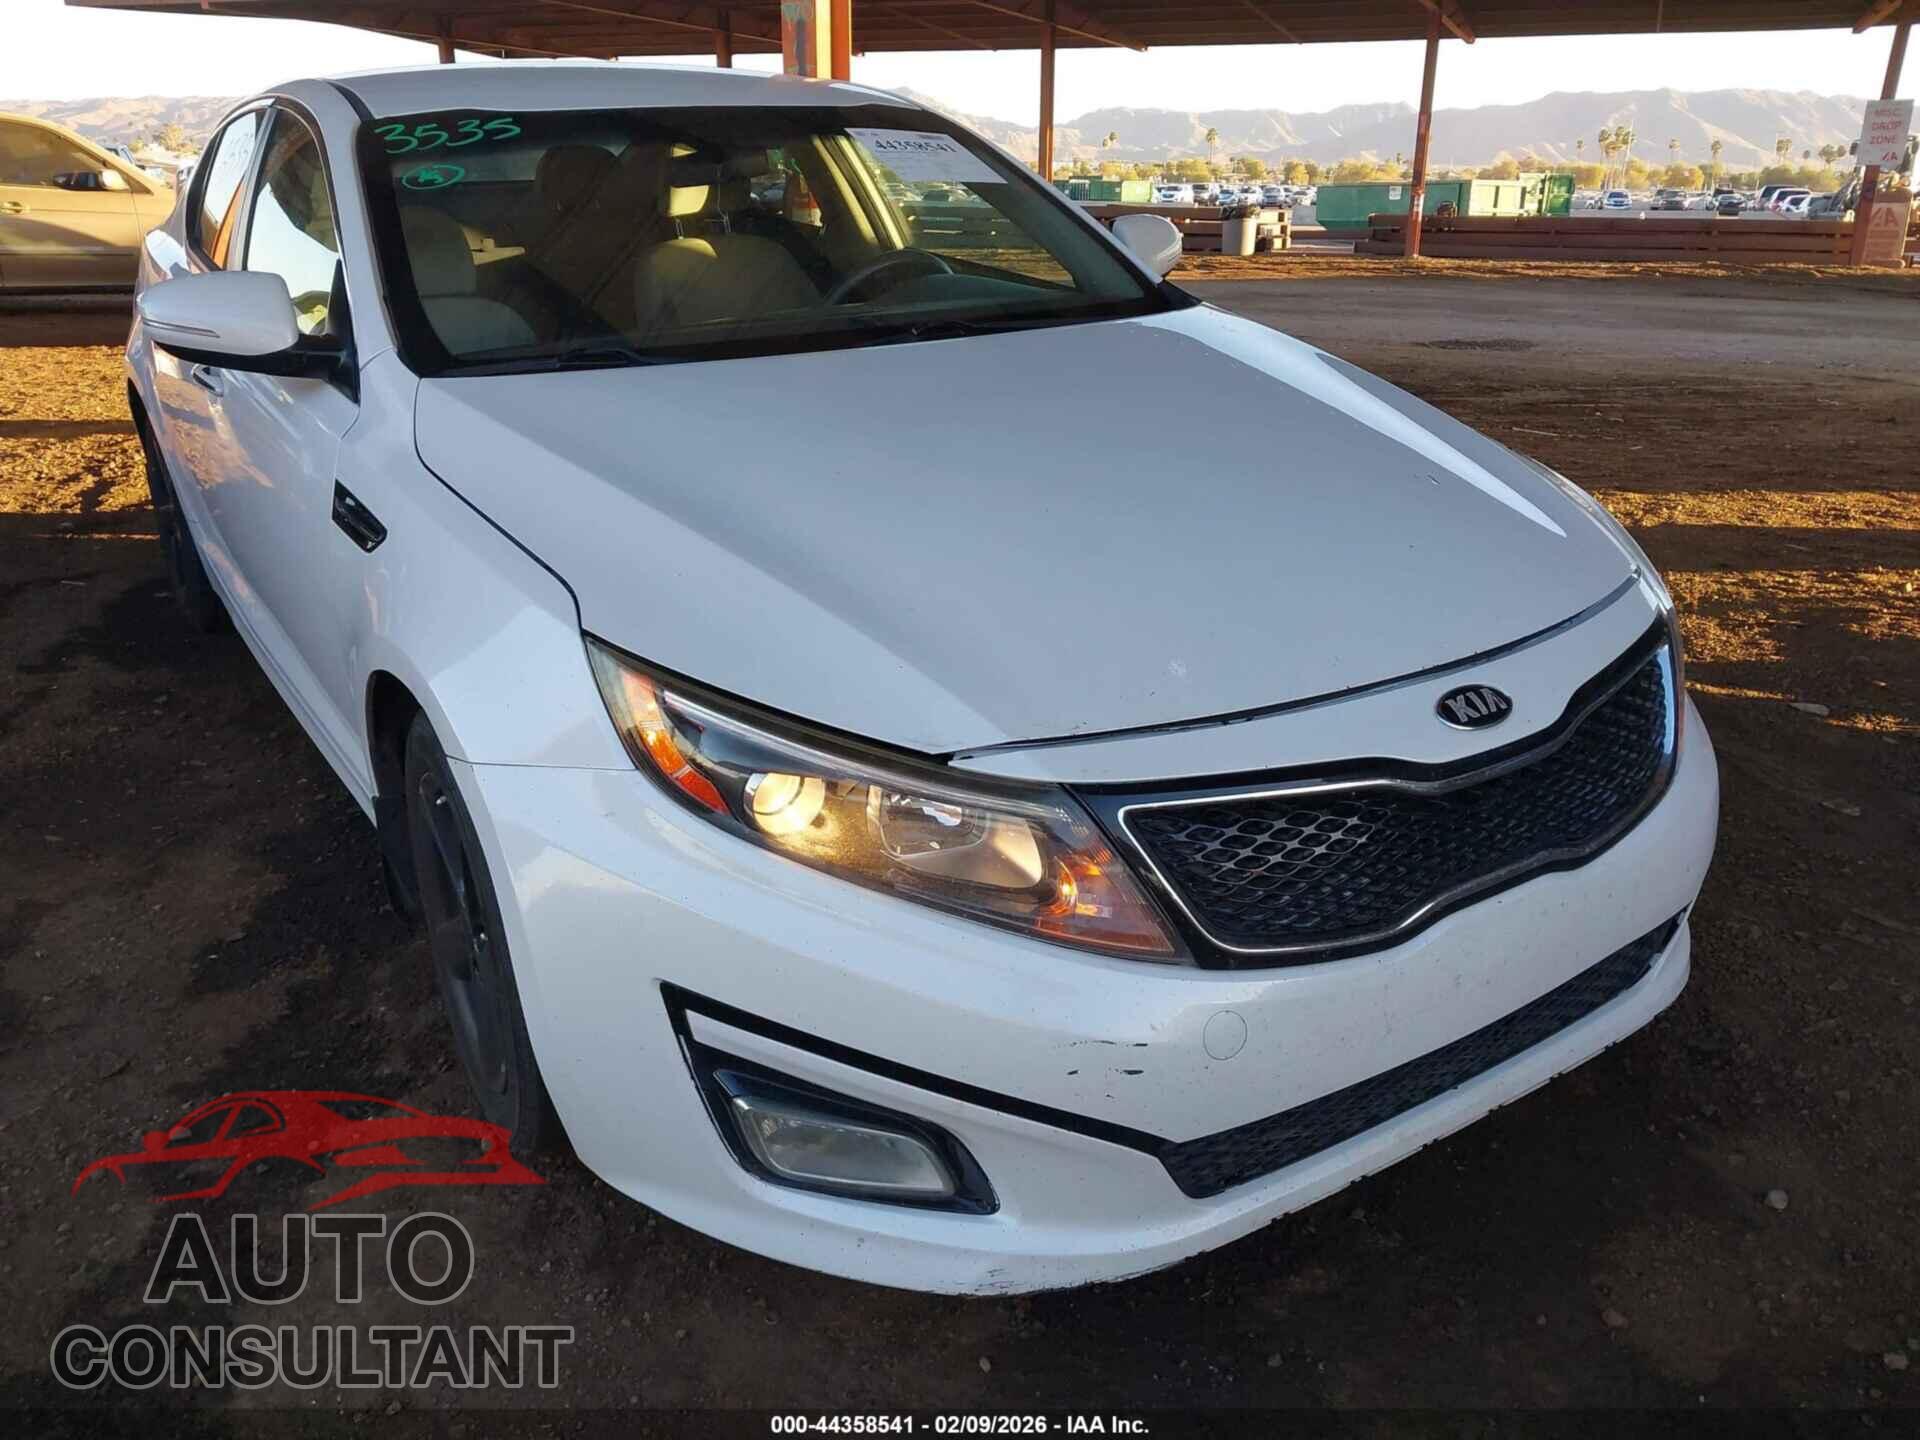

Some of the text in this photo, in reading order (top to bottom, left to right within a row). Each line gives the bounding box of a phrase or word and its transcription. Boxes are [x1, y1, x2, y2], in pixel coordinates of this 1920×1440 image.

[1871, 120, 1902, 131] DROP
[374, 117, 521, 154] 3535
[1870, 135, 1897, 145] ZONE
[874, 139, 957, 153] 44358541
[1445, 688, 1508, 723] KIA
